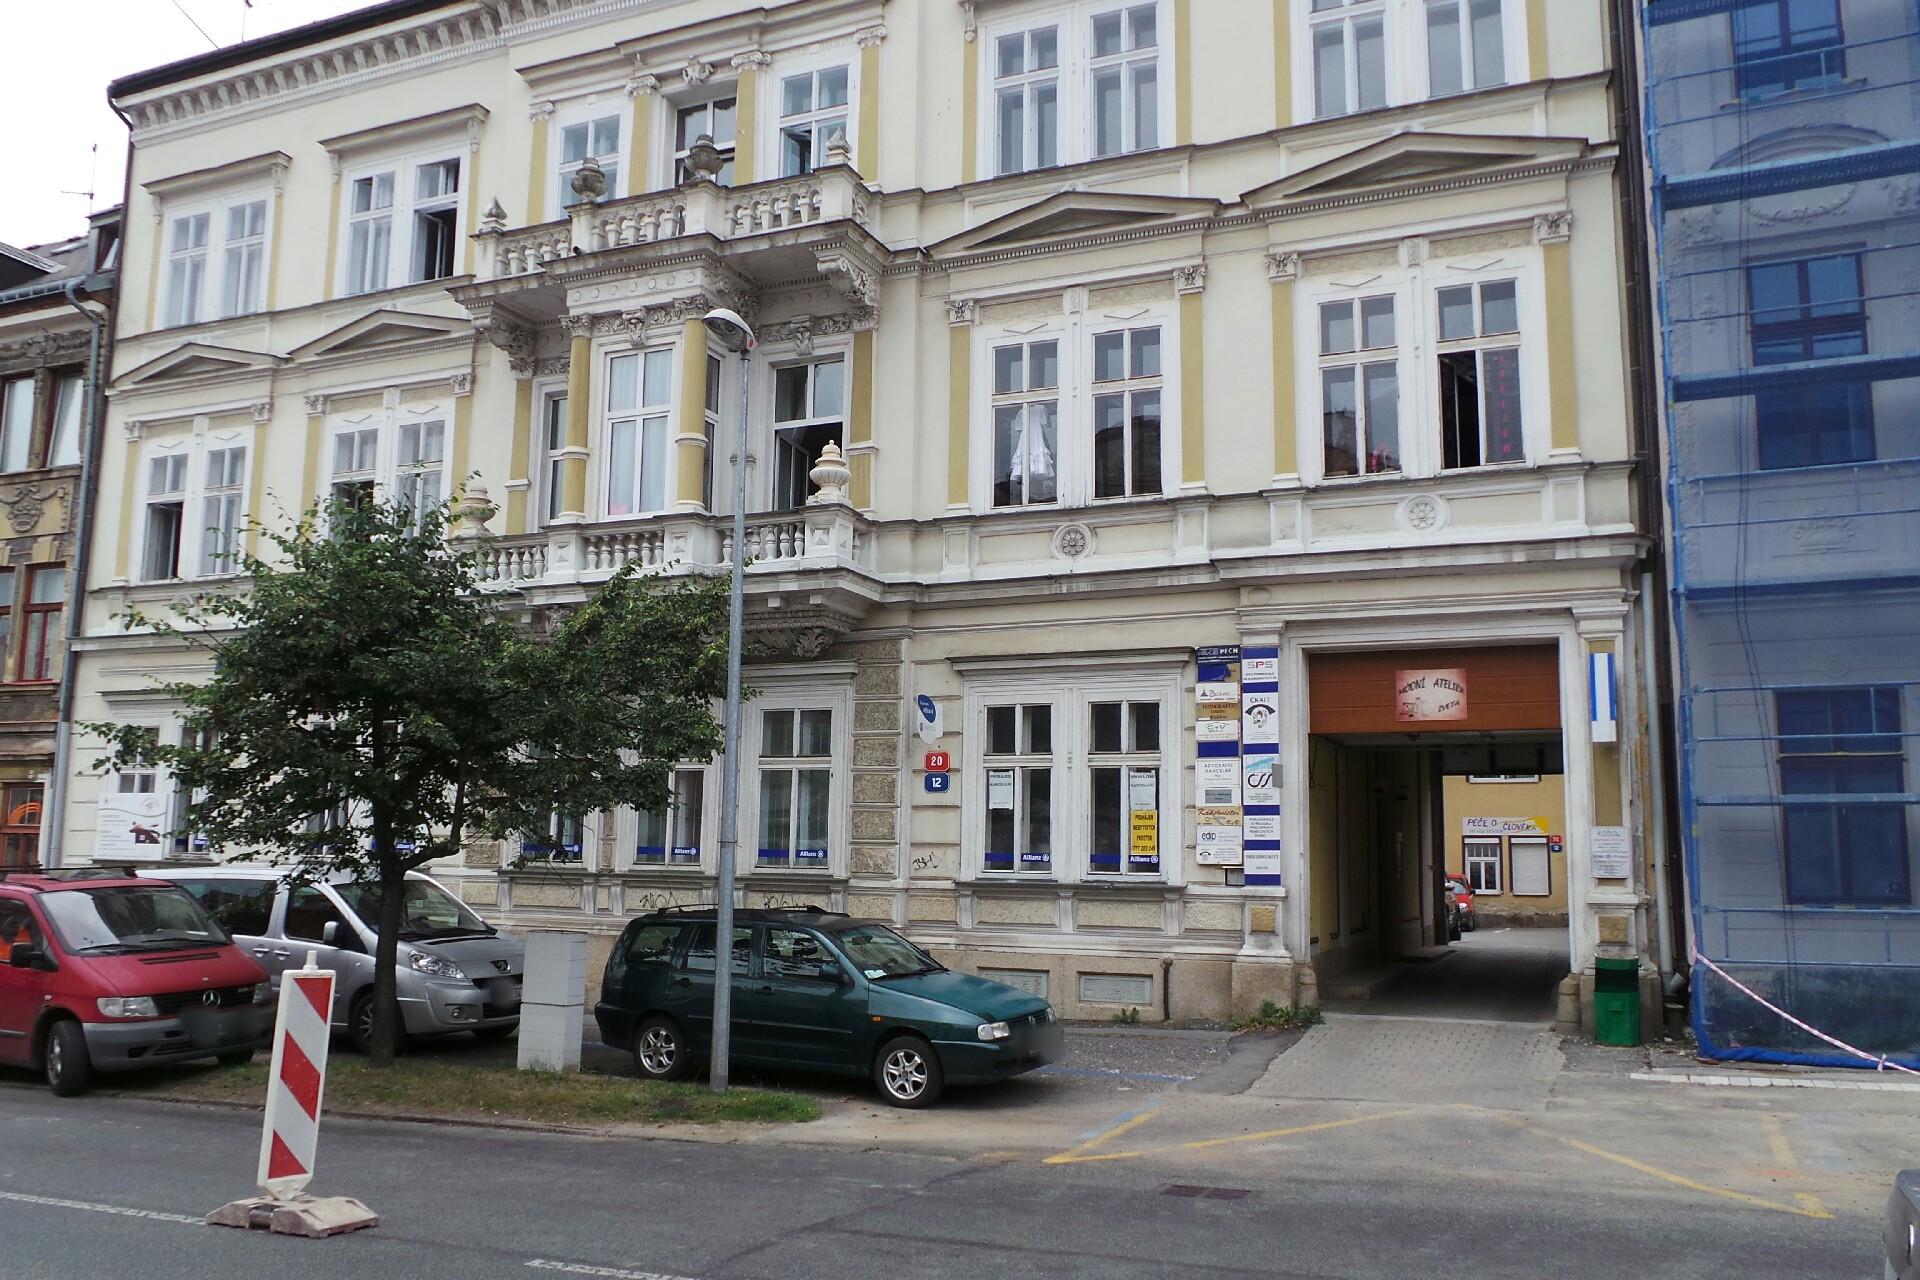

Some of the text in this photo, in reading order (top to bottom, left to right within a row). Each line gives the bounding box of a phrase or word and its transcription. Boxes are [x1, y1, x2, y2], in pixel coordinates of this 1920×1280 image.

[1247, 661, 1273, 669] SPS
[1399, 675, 1465, 696] MÓDNÍ ATELIER
[1438, 700, 1460, 712] IVETA
[931, 755, 943, 766] 20
[931, 777, 942, 788] 12
[1467, 817, 1497, 827] PEČE O
[1129, 855, 1150, 863] Allianz
